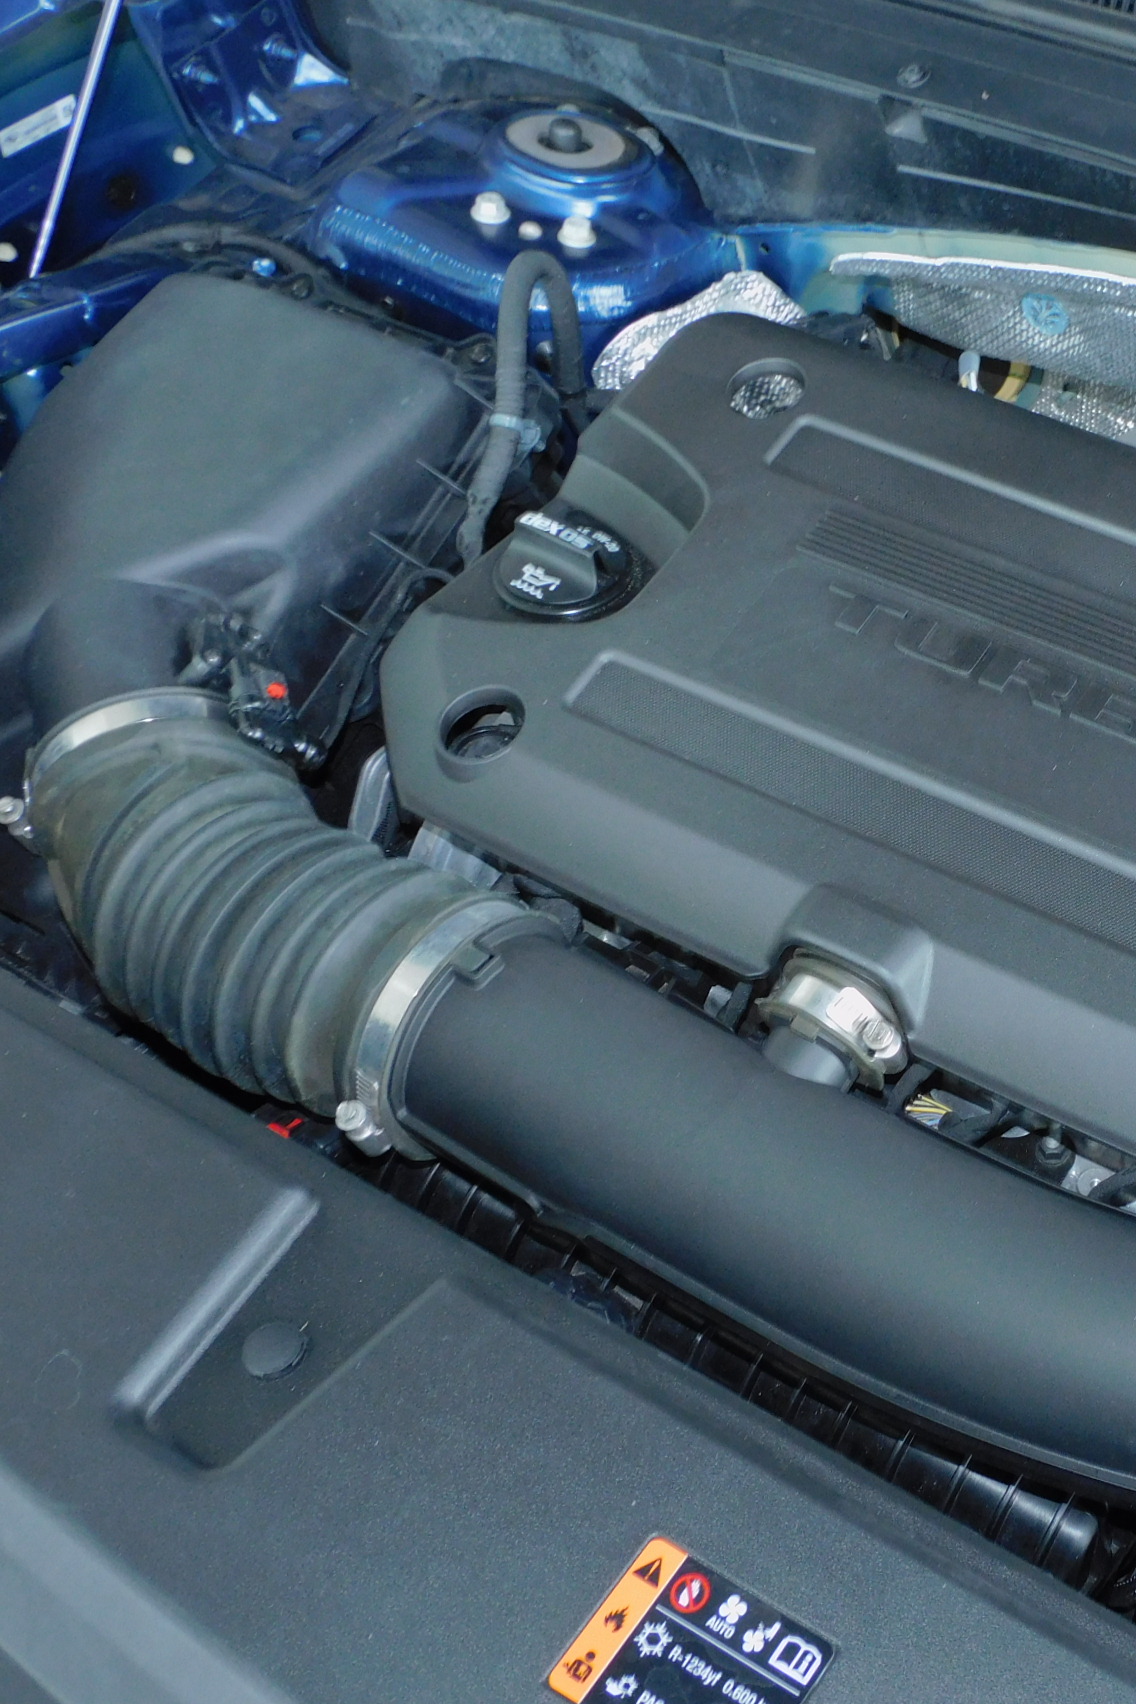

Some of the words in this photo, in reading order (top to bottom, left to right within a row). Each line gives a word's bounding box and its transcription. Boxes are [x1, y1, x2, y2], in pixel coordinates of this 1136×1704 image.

[520, 511, 594, 549] dexos
[705, 1615, 736, 1639] AUTO
[722, 1679, 757, 1704] 0.600
